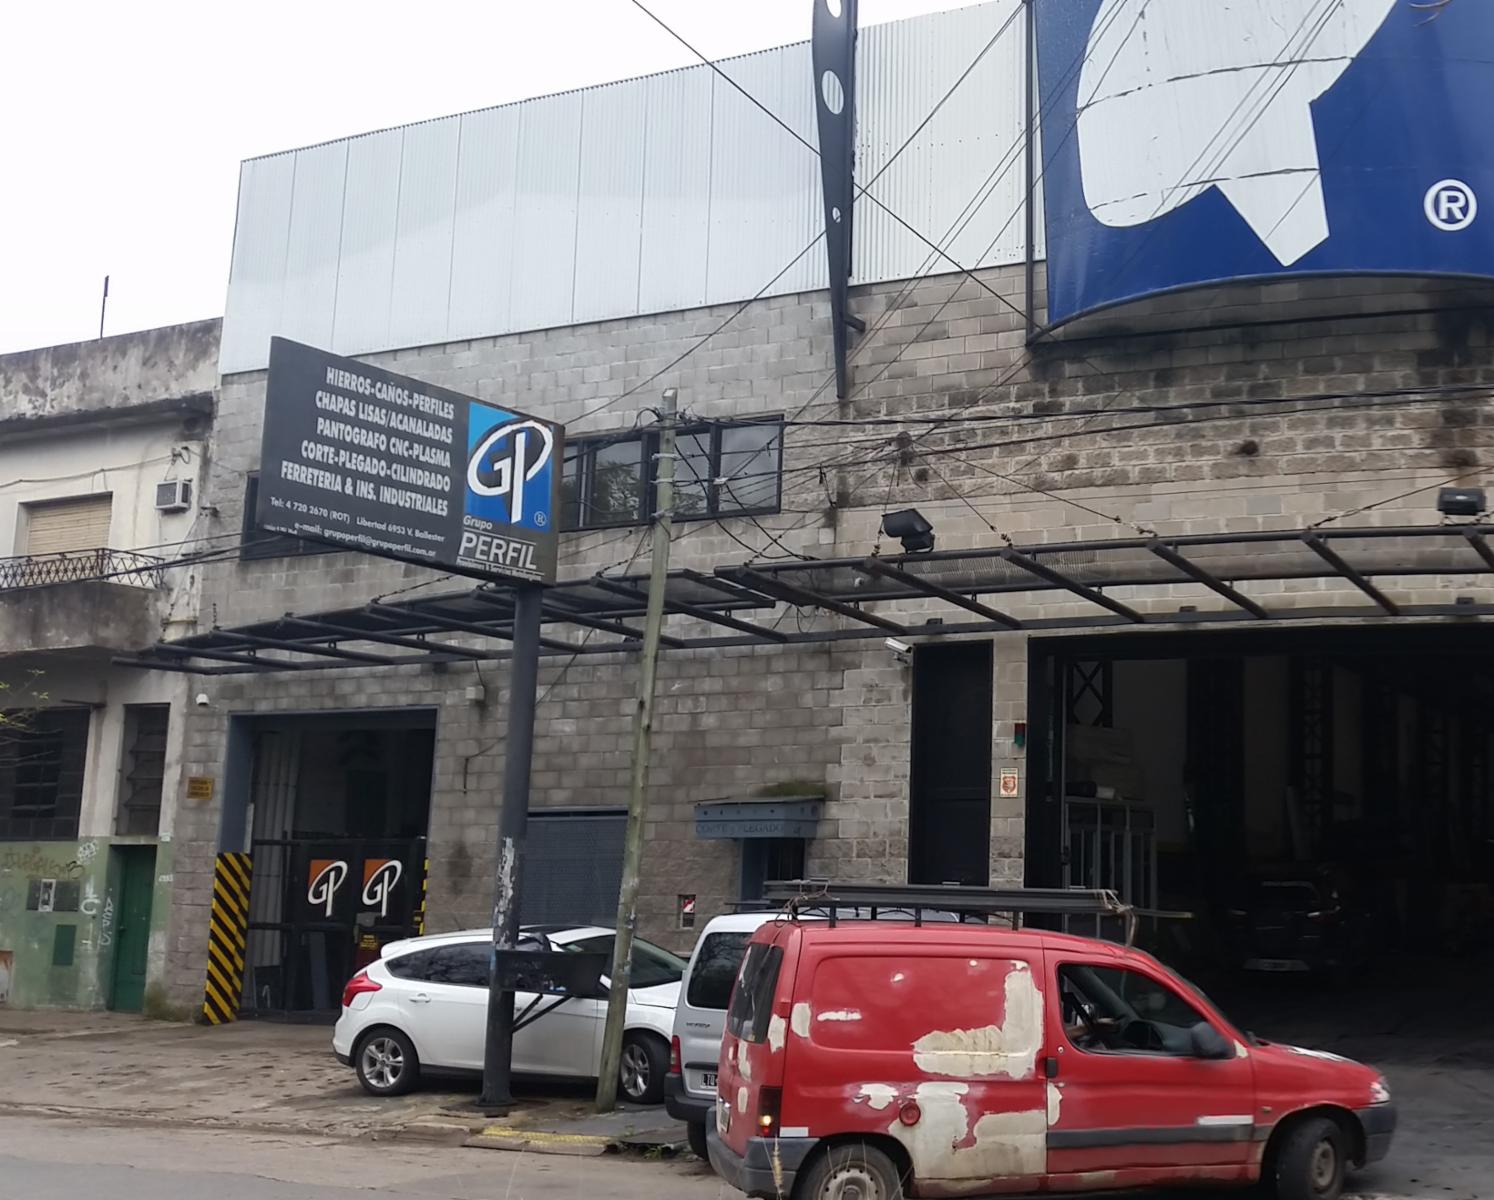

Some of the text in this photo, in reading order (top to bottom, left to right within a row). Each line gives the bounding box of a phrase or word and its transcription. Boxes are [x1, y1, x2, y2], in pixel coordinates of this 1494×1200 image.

[315, 390, 453, 444] CHAPAS LISAS/ACANALADAS
[316, 417, 451, 467] PANTOGRAFO CNC-PLASMA
[281, 460, 449, 516] FERRETERIA & INS. INDUSTRIALES
[301, 439, 451, 492] CORTE-PLEGADO-CILINDRADO
[293, 501, 308, 513] 720
[309, 505, 329, 518] 2670
[329, 510, 351, 524] (ROT)
[356, 516, 387, 531] Libertad
[463, 515, 493, 530] Grupo
[458, 531, 537, 570] PERFIL
